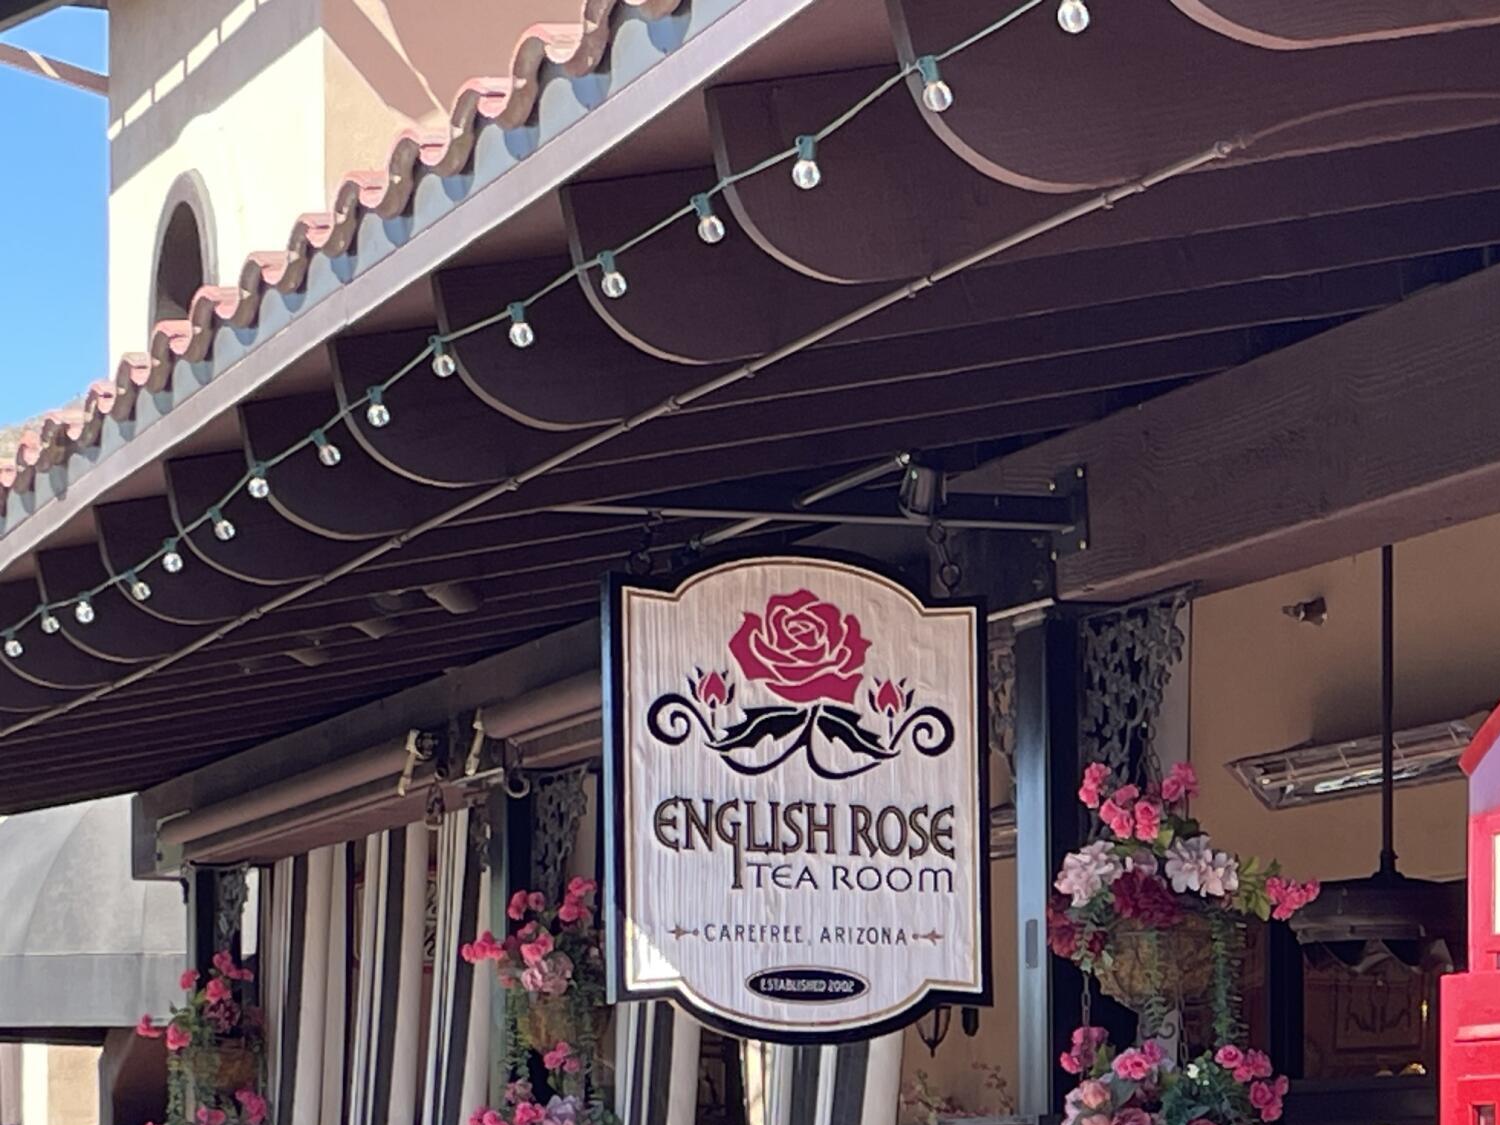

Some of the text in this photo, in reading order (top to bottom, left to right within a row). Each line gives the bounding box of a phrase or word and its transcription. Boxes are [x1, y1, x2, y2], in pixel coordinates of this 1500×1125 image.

[653, 796, 956, 889] ENGLISH ROSE
[746, 862, 955, 892] TEA ROOM
[820, 926, 908, 946] ARIZONA
[760, 978, 856, 993] ESTABLISHED 2002
